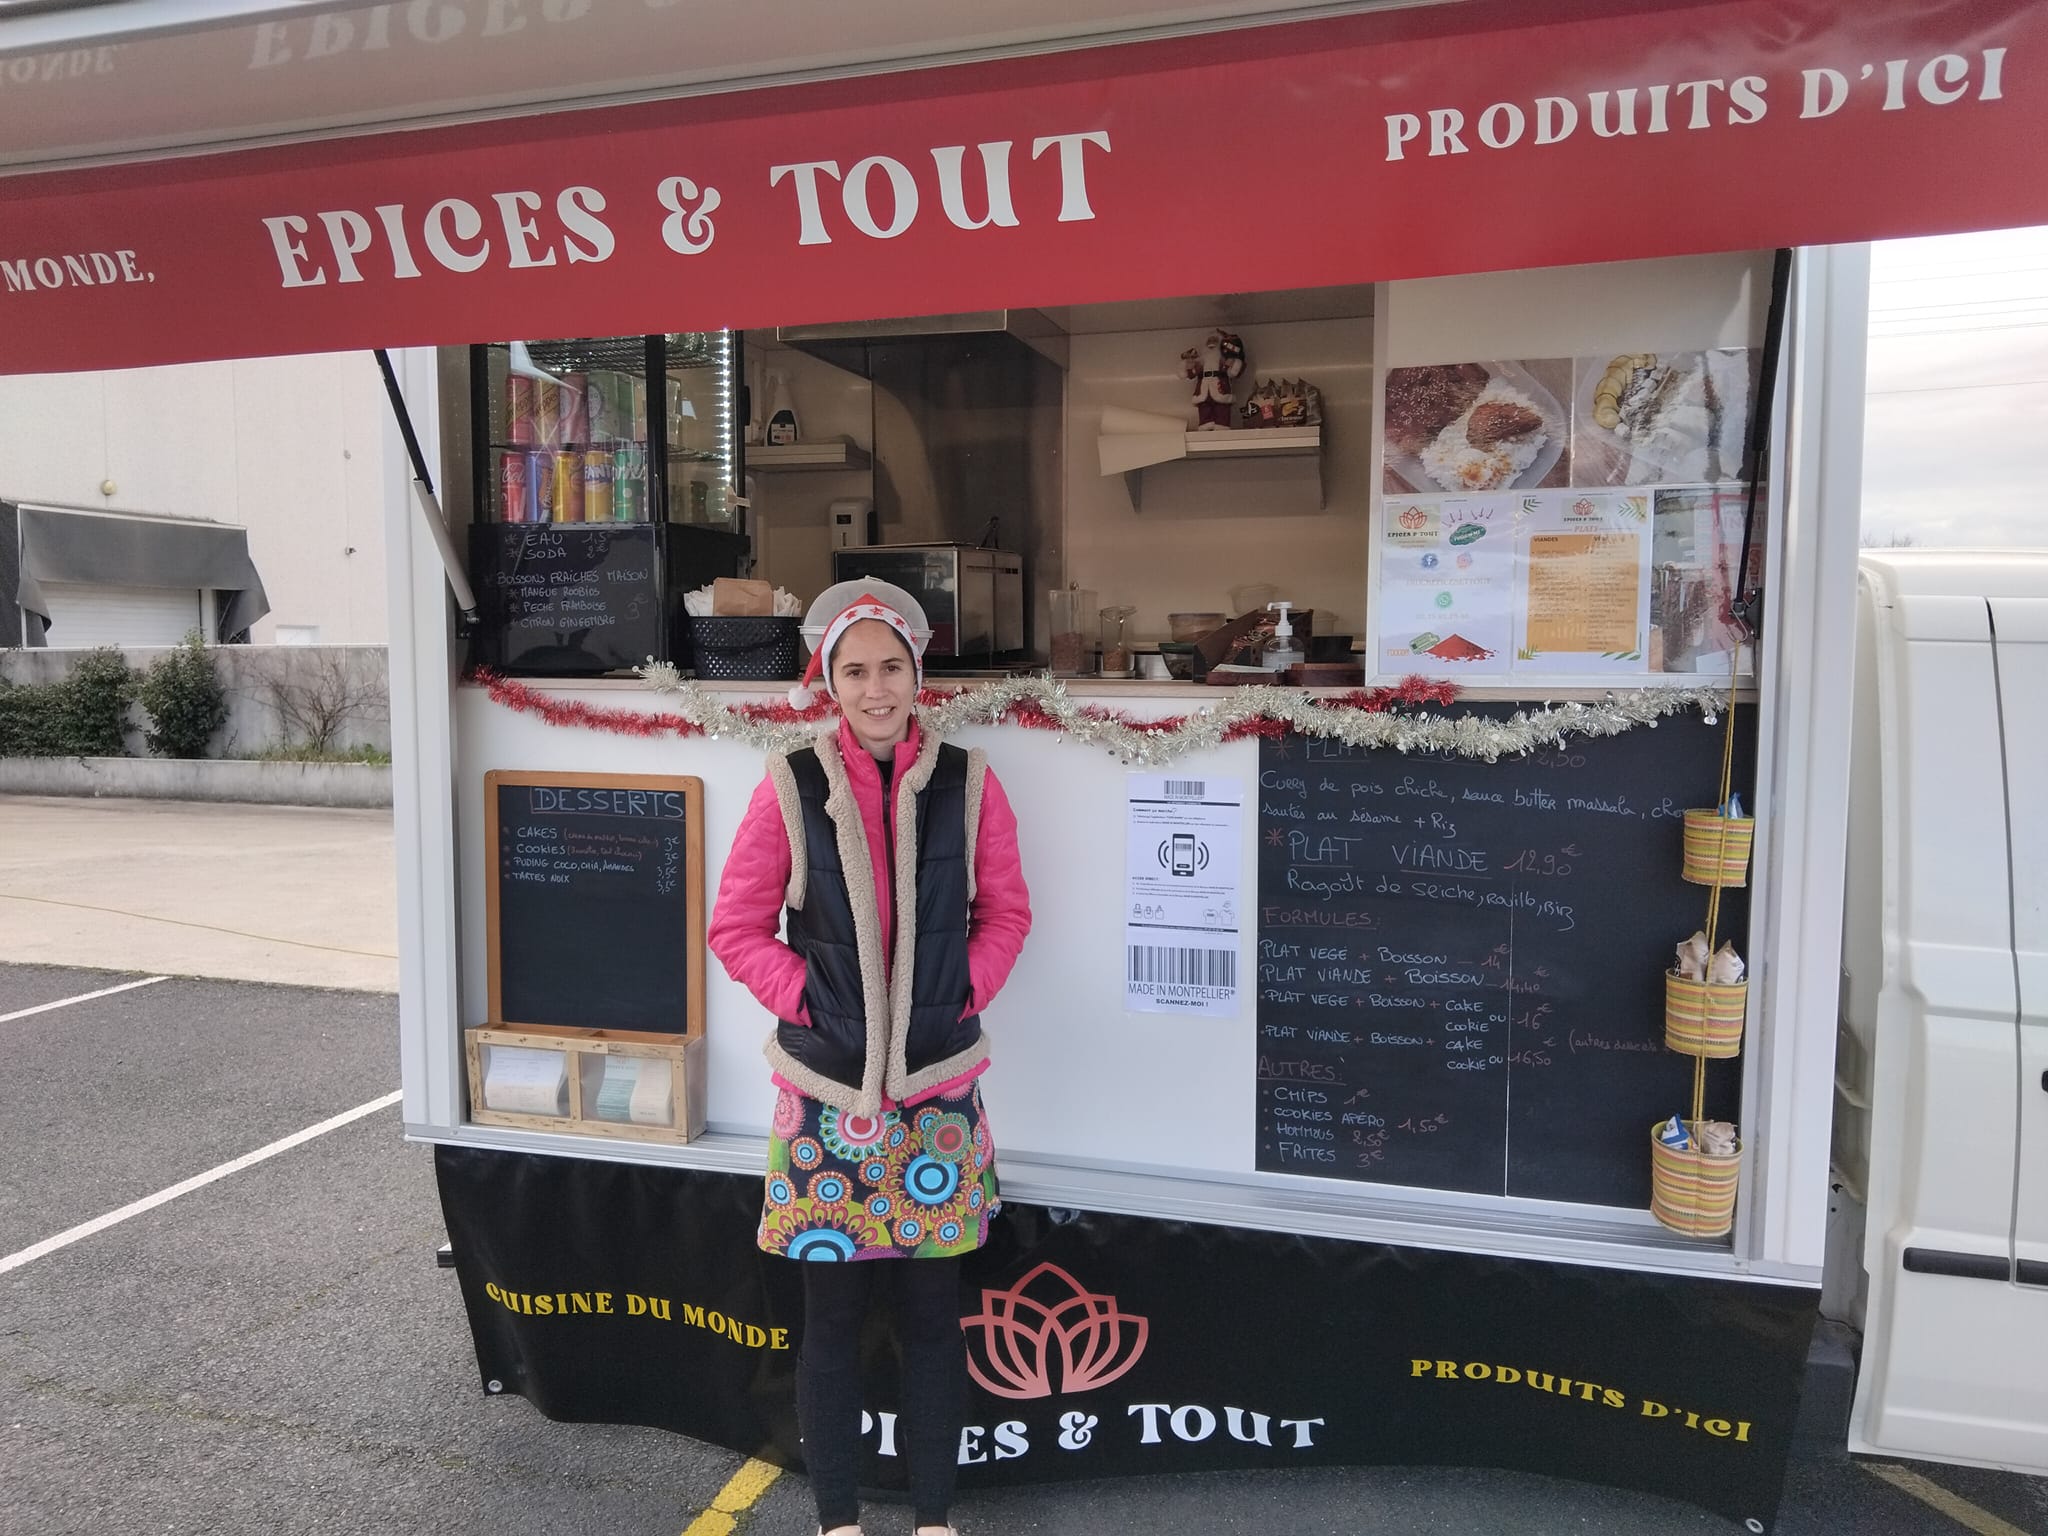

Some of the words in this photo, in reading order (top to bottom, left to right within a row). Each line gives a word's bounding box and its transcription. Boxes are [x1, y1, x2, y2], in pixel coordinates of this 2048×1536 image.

[1384, 75, 1768, 162] PRODUITS
[1799, 47, 2007, 119] D'ICI
[261, 185, 617, 288] EPICES
[657, 176, 722, 255] &
[769, 130, 1112, 245] TOUT
[0, 248, 156, 293] MONDE,
[526, 533, 564, 546] EAU
[524, 547, 568, 560] SODA
[521, 587, 557, 597] MANGUE
[1319, 778, 1340, 793] de
[1351, 781, 1384, 798] pois
[534, 787, 685, 819] DESSERTS
[517, 826, 557, 839] CAKES
[1317, 810, 1338, 821] au
[1431, 812, 1457, 839] Riz
[516, 843, 566, 855] COOKIES
[1288, 830, 1363, 863] PLAT
[1391, 840, 1488, 872] VIANDE
[513, 856, 549, 868] PUDING
[511, 871, 546, 882] TARTES
[550, 873, 570, 883] NOIX
[1375, 874, 1402, 893] de
[1259, 938, 1302, 959] PLAT
[1259, 963, 1307, 984] PLAT
[1317, 967, 1373, 985] VIANDE
[1128, 982, 1154, 996] MADE
[1156, 984, 1166, 996] IN
[1264, 989, 1307, 1004] PLAT
[1264, 1024, 1299, 1039] PLAT
[1306, 1027, 1351, 1043] VIANDE
[1274, 1087, 1329, 1104] CHIPS
[1273, 1107, 1333, 1122] COOKIES
[1278, 1141, 1337, 1162] FRITES
[485, 1282, 614, 1315] CUISINE
[626, 1293, 671, 1321] DU
[682, 1303, 790, 1350] MONDE
[1410, 1359, 1625, 1408] PRODUITS
[1641, 1400, 1752, 1442] D'ICI
[1058, 1411, 1098, 1450] &
[1128, 1403, 1325, 1449] TOUT
